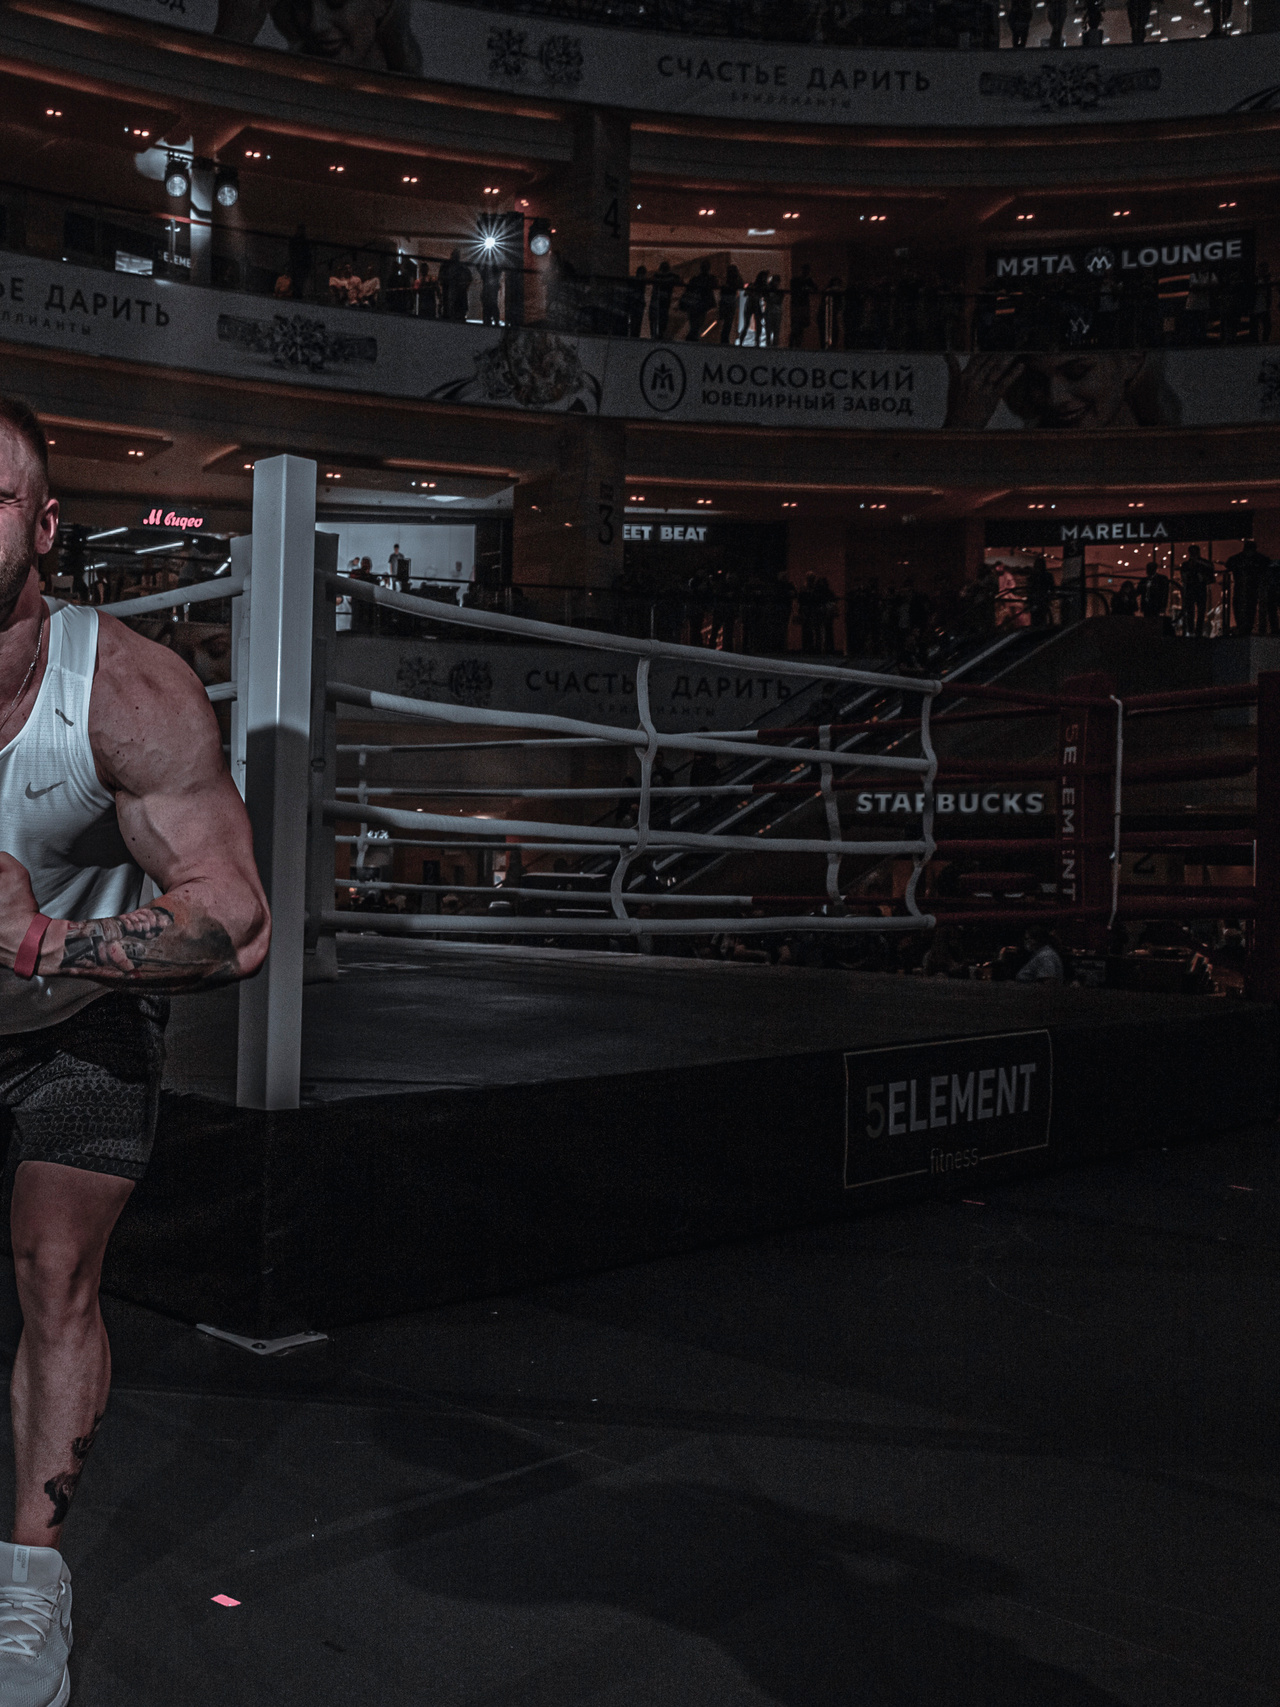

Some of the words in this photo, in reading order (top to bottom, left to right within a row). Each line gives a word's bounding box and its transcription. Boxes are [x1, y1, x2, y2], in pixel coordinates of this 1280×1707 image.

[657, 55, 787, 86] СЧАСТЬЕ
[806, 66, 931, 92] ДАРИТЬ
[996, 253, 1077, 277] МЯТА
[1121, 239, 1243, 270] LOUNGE
[45, 284, 171, 327] ДАРИТЬ
[702, 361, 915, 393] МОСКОВСКИЙ
[702, 390, 836, 412] ЮВЕЛИРНЫЙ
[844, 396, 913, 417] ЗАВОД
[623, 524, 653, 541] EET
[660, 525, 708, 542] BEAT
[1060, 522, 1169, 541] MARELLA
[525, 670, 652, 696] СЧАСТЬ
[672, 676, 792, 700] ДАРИТЬ
[865, 1063, 1036, 1139] 5ELEMENT
[930, 1148, 979, 1174] fitness
